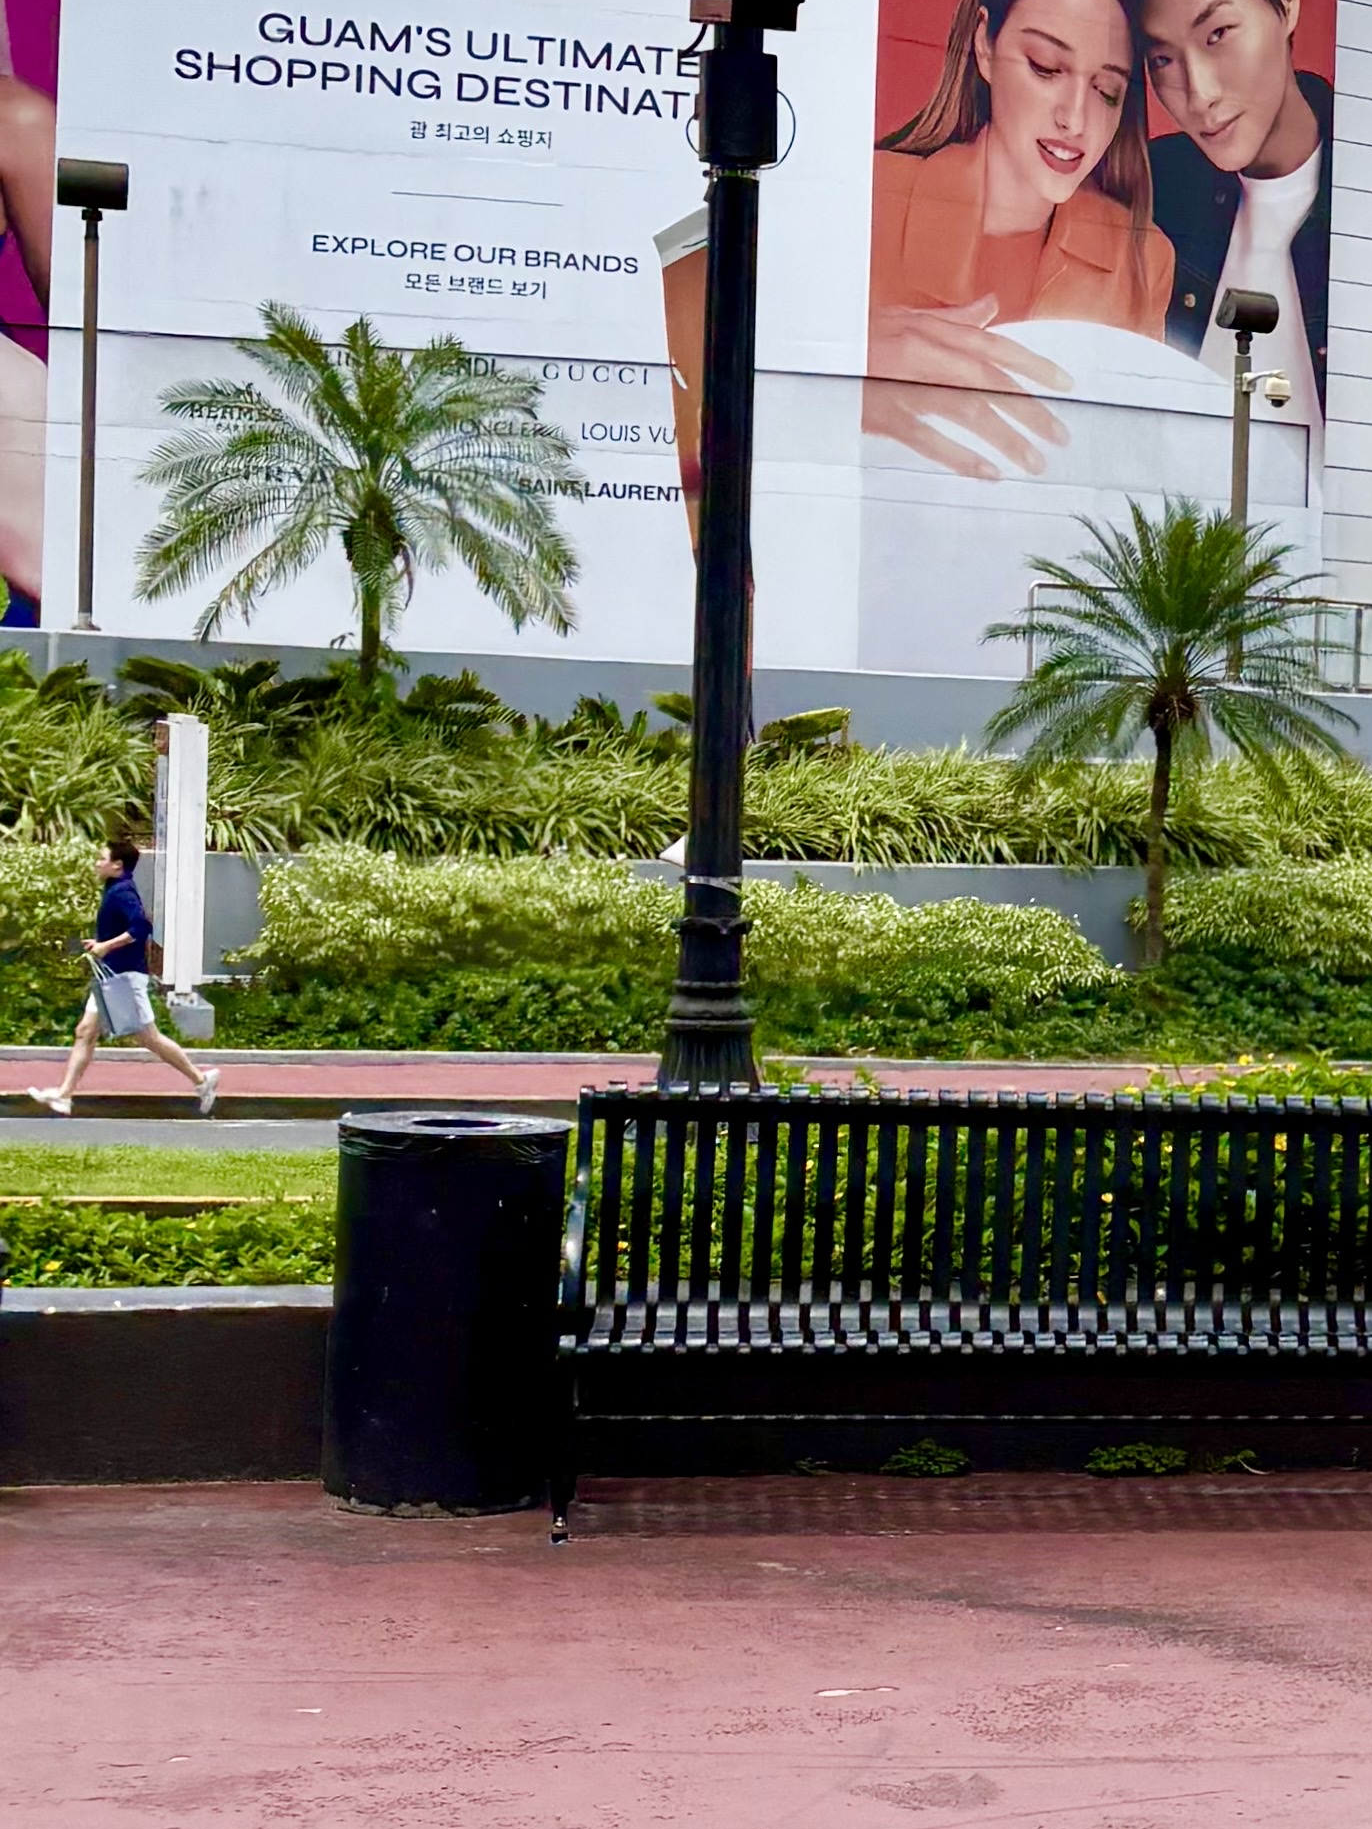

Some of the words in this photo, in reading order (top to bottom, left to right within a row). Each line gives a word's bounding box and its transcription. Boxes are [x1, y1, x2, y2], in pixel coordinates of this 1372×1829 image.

[258, 12, 452, 57] GUAM'S
[466, 29, 700, 77] ULTIMATE
[174, 48, 442, 100] SHOPPING
[435, 122, 490, 144] 최고의
[496, 128, 552, 150] 쇼핑지
[312, 234, 447, 261] EXPLORE
[453, 244, 517, 266] OUR
[524, 250, 639, 274] BRANDS
[405, 274, 442, 292] 모든
[447, 276, 503, 296] 브랜드
[510, 280, 547, 300] 보기
[542, 362, 649, 385] GUCCI
[581, 422, 641, 444] LOUIS
[584, 481, 683, 503] LAURENT
